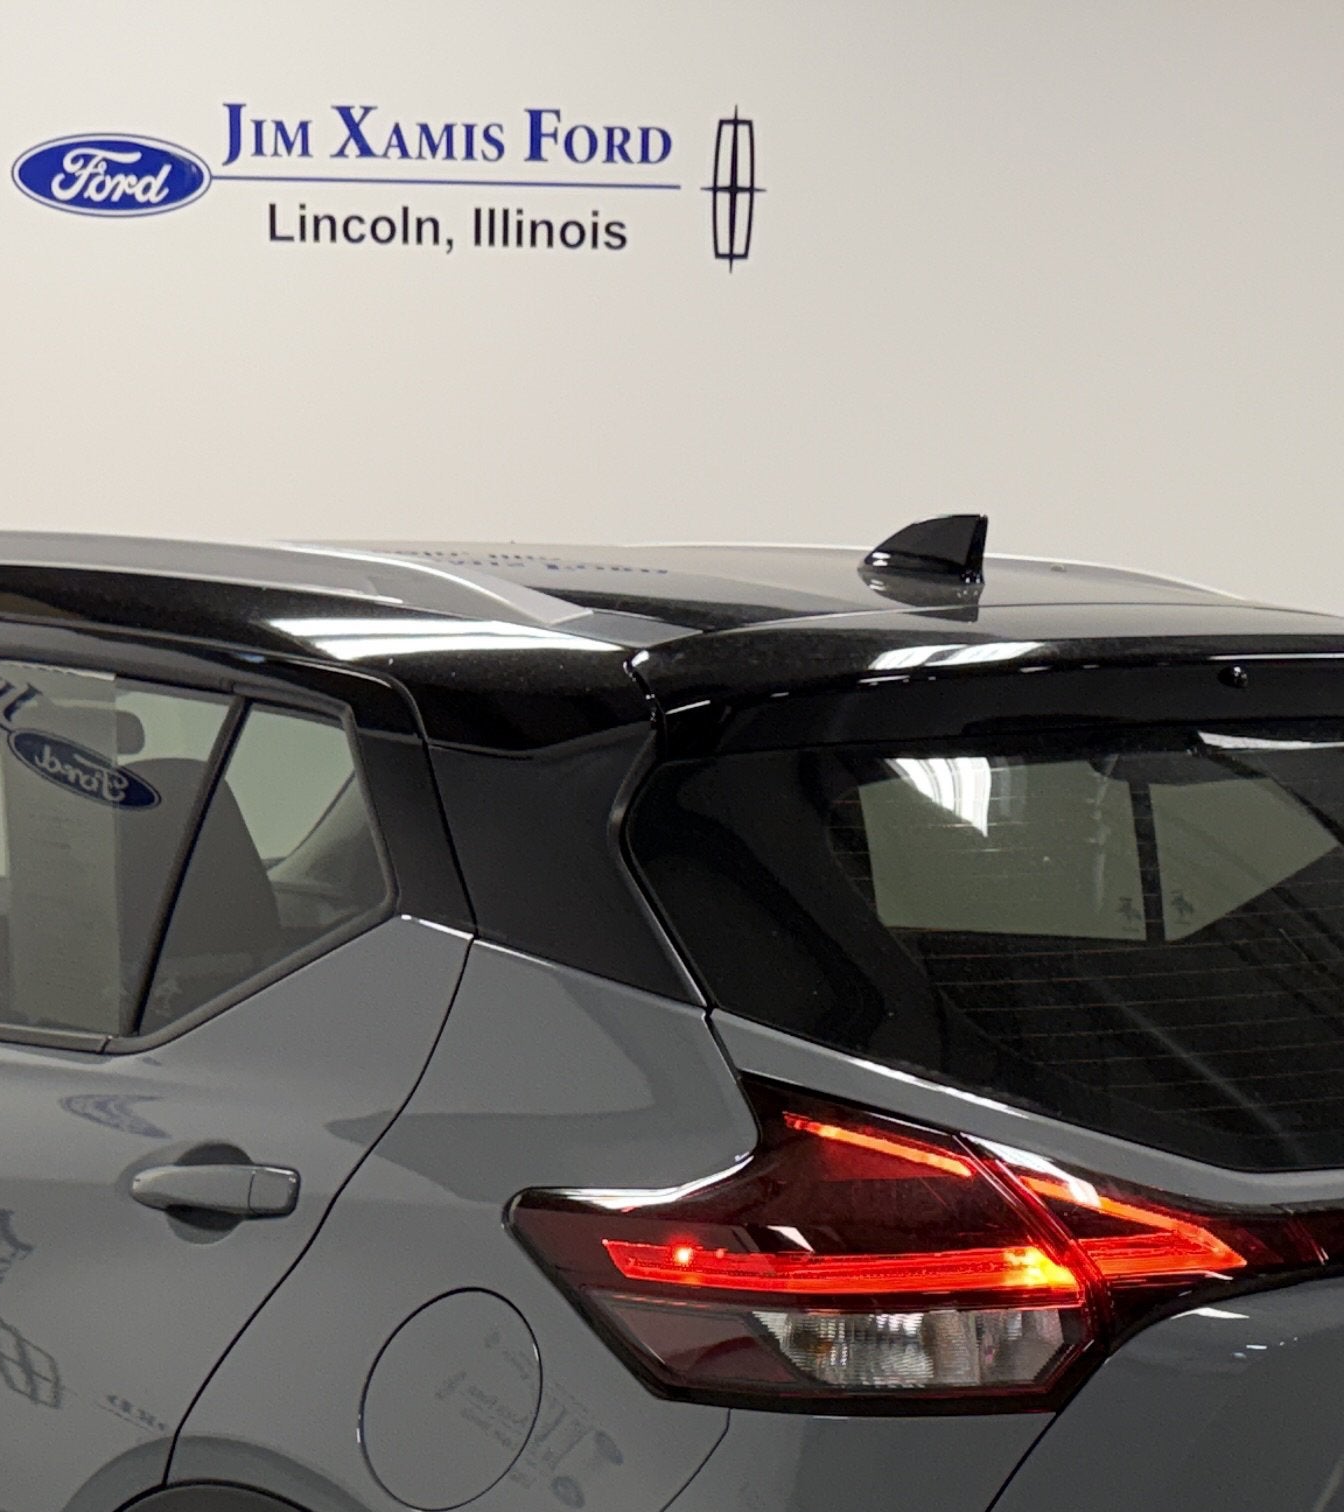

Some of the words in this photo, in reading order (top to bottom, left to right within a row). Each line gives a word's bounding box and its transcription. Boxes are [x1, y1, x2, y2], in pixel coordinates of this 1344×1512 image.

[222, 103, 311, 166] JIM
[331, 105, 505, 163] XAMIS
[524, 108, 672, 164] FORD
[51, 147, 169, 204] Ford
[268, 203, 454, 253] Lincoln,
[473, 207, 627, 250] Illinois
